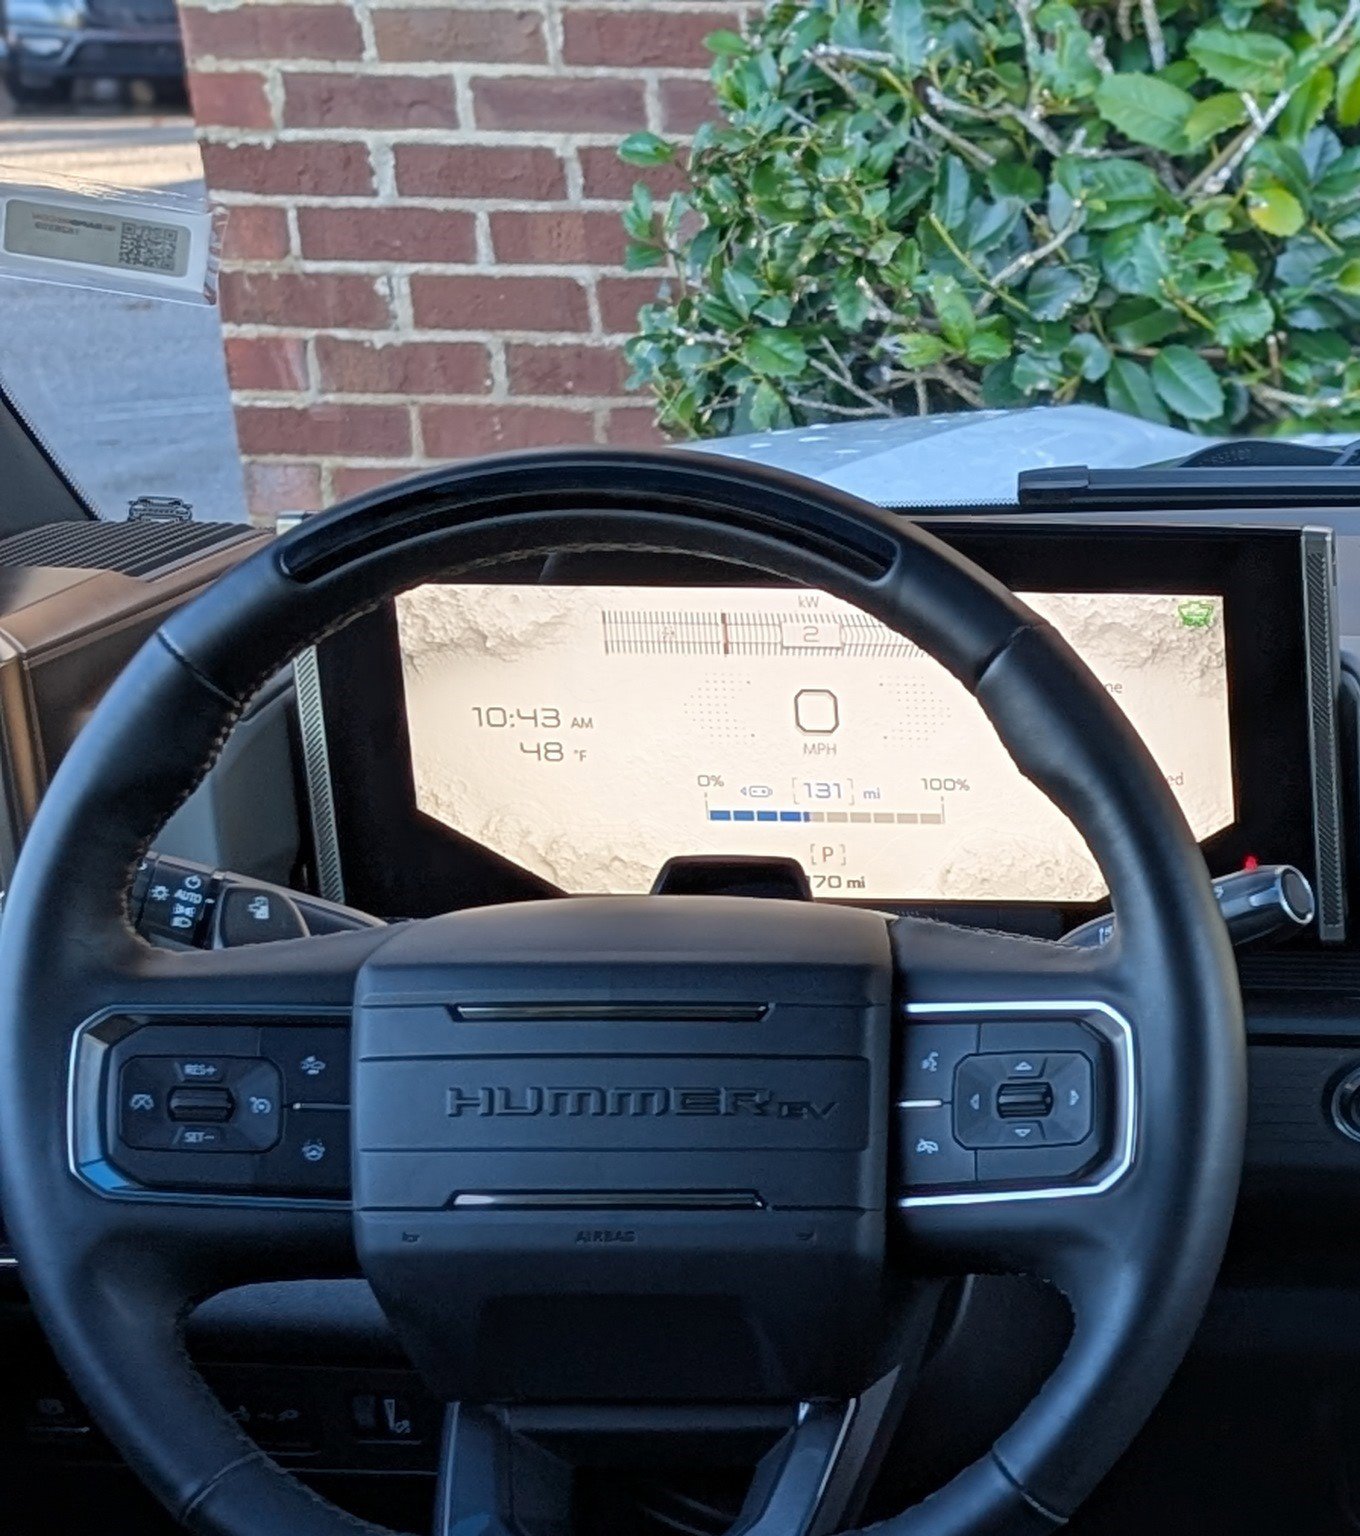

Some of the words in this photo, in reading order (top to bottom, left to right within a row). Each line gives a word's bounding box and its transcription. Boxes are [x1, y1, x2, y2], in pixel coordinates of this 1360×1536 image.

[798, 595, 819, 609] kW
[803, 625, 820, 642] 2
[472, 706, 562, 729] 10:43
[570, 716, 594, 730] AM
[519, 741, 564, 763] 48
[803, 742, 837, 755] MPH
[697, 774, 725, 788] 0%
[921, 777, 971, 791] 100%
[803, 782, 842, 799] 131
[862, 787, 881, 800] mi
[821, 846, 834, 863] P
[847, 876, 866, 889] mi
[174, 889, 203, 904] AUTO
[446, 1085, 775, 1118] HUMMER
[574, 1229, 638, 1244] AIRBAG
